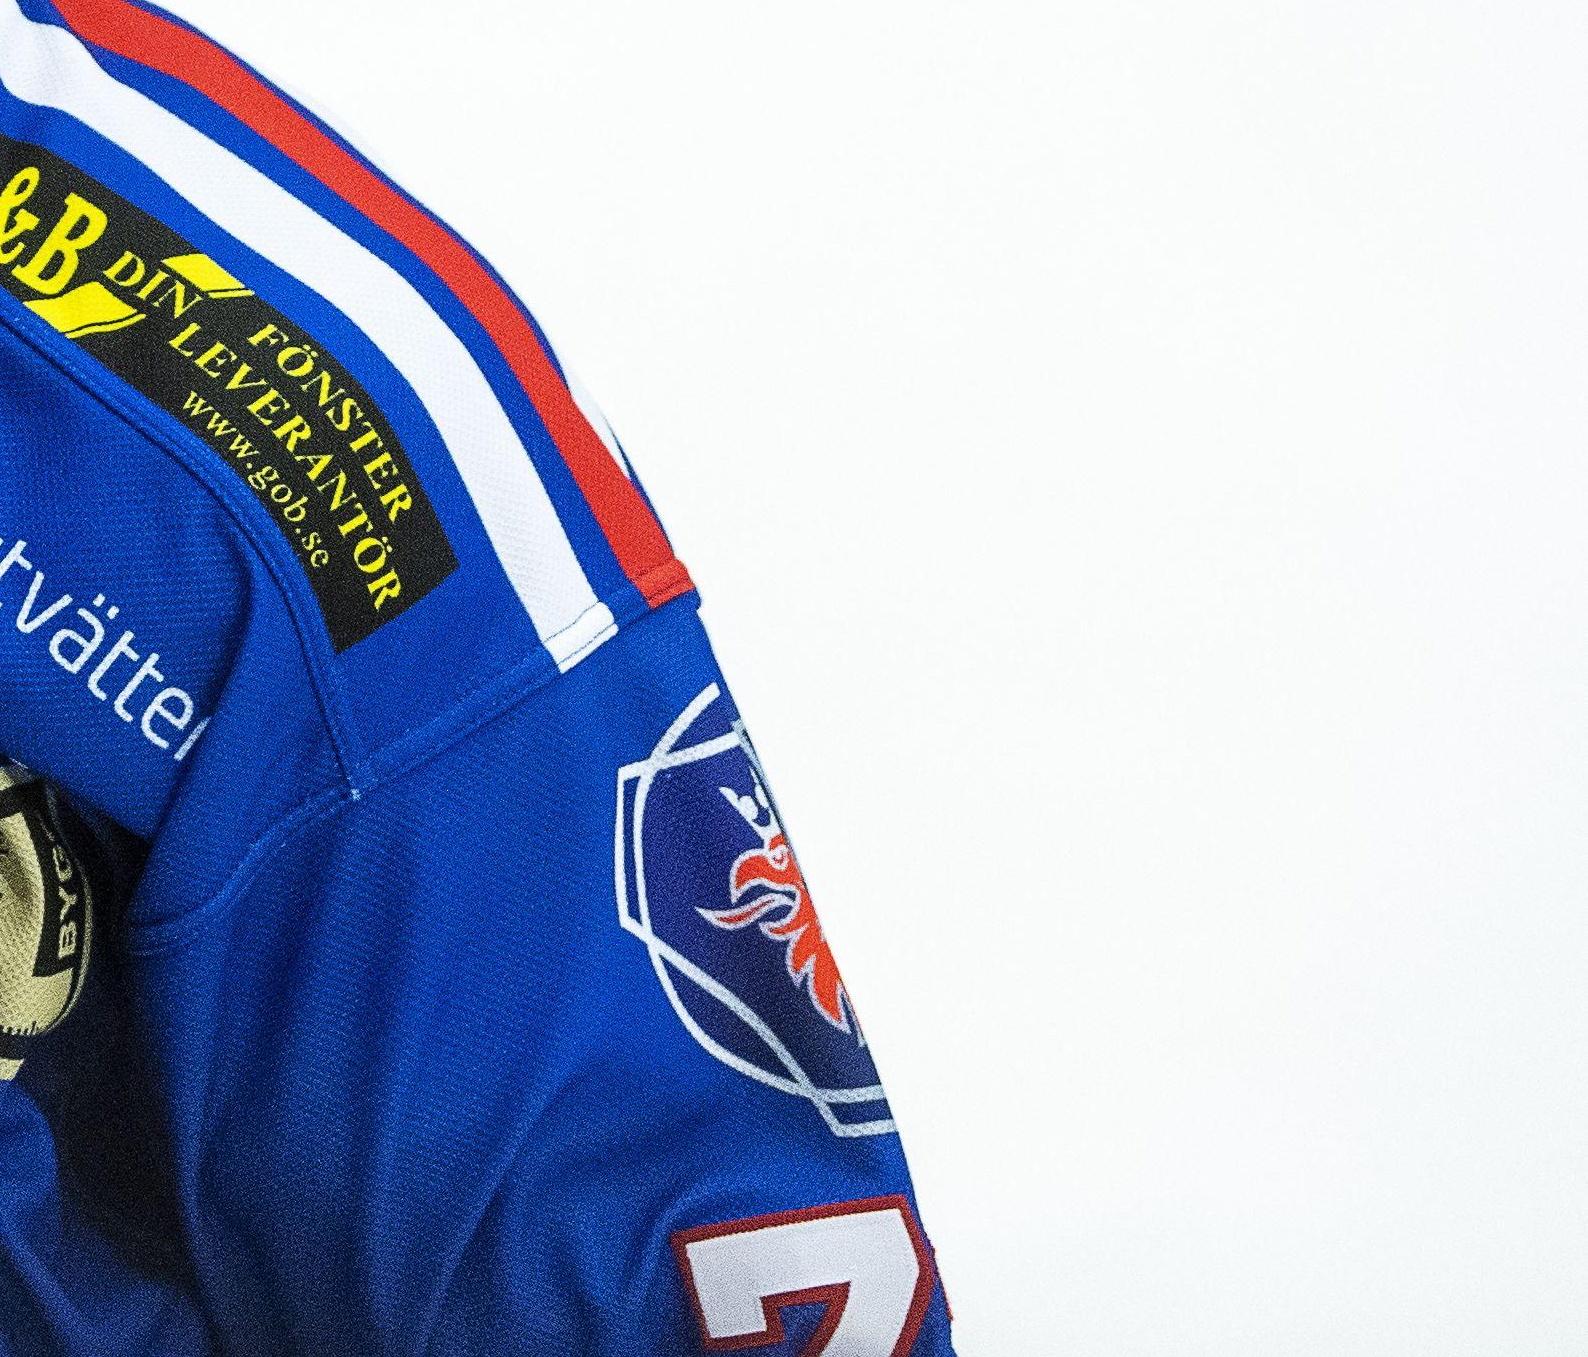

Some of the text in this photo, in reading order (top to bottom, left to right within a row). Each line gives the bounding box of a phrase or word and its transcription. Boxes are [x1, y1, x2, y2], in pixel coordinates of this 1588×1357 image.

[103, 249, 204, 320] DIN
[168, 322, 406, 612] LEVERANTÖR
[181, 390, 330, 571] www.gob.se
[247, 323, 413, 524] FÖNSTER
[38, 807, 78, 962] BYG
